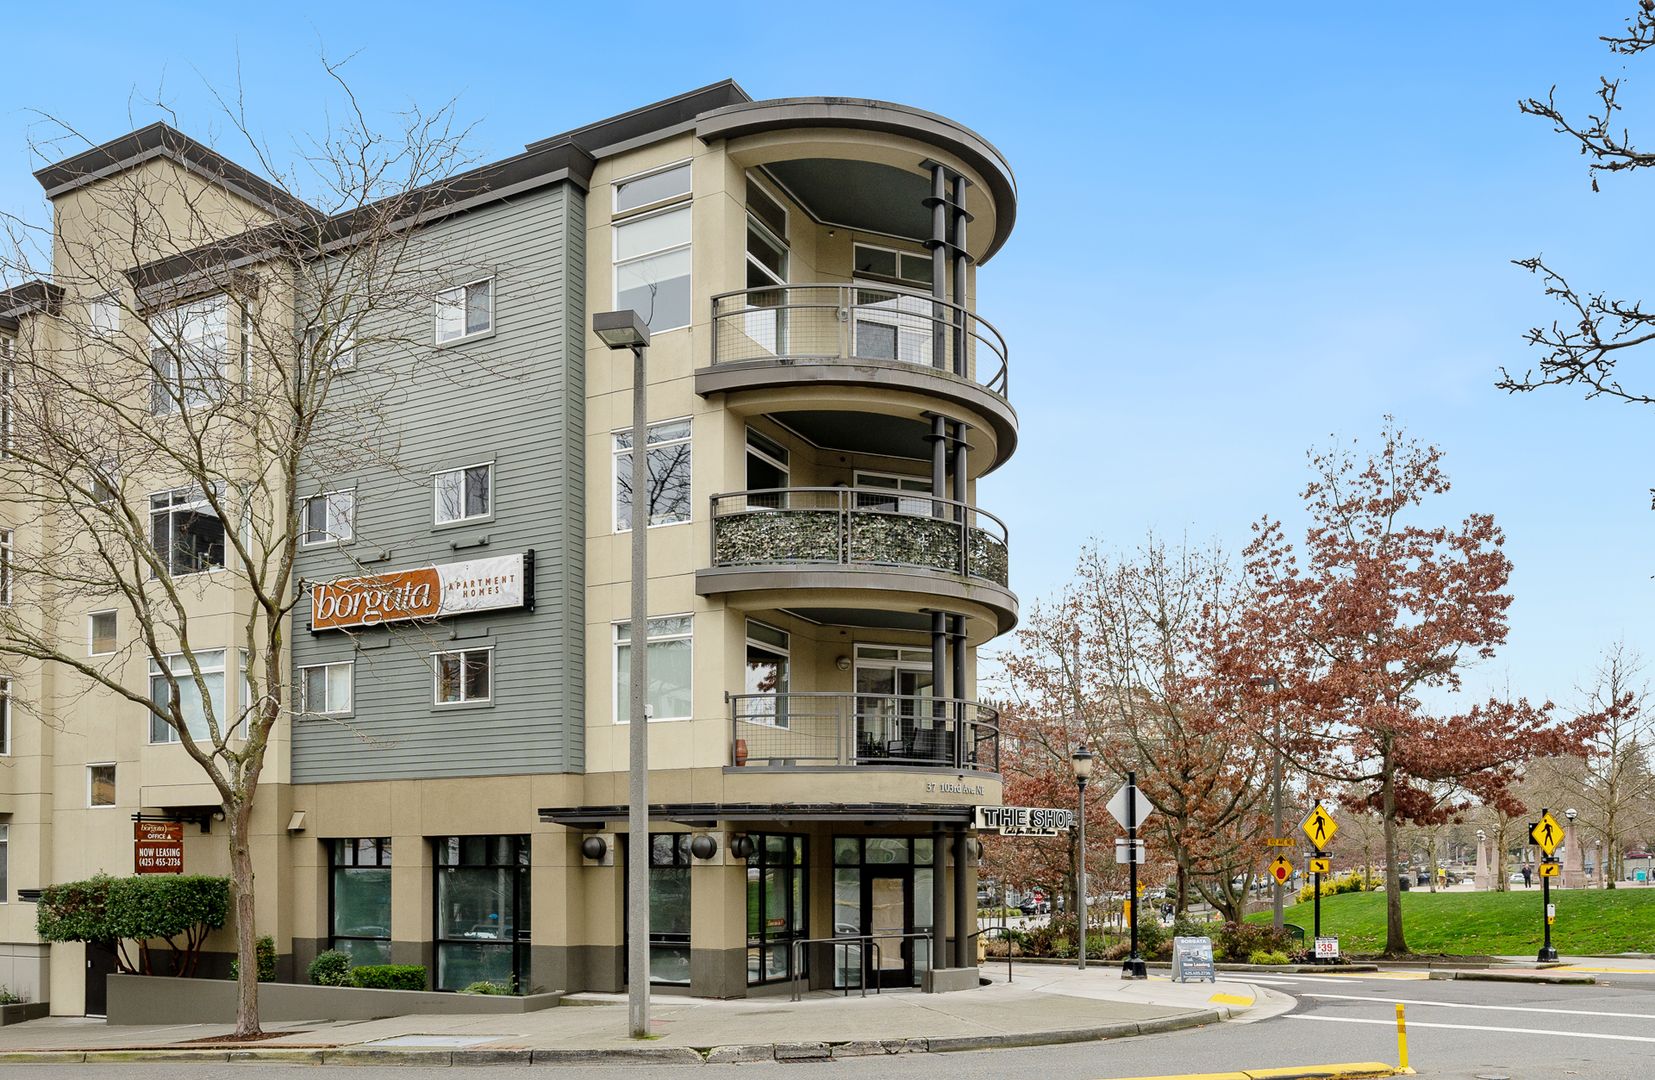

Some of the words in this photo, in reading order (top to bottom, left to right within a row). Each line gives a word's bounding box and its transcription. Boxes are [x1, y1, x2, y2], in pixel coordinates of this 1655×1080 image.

[449, 575, 515, 590] APARTMENT
[463, 586, 500, 598] HOMES
[317, 582, 432, 626] borgata
[983, 808, 1028, 827] THE
[1032, 809, 1073, 829] SHOP
[139, 848, 155, 857] NOW
[155, 848, 181, 857] LEASING
